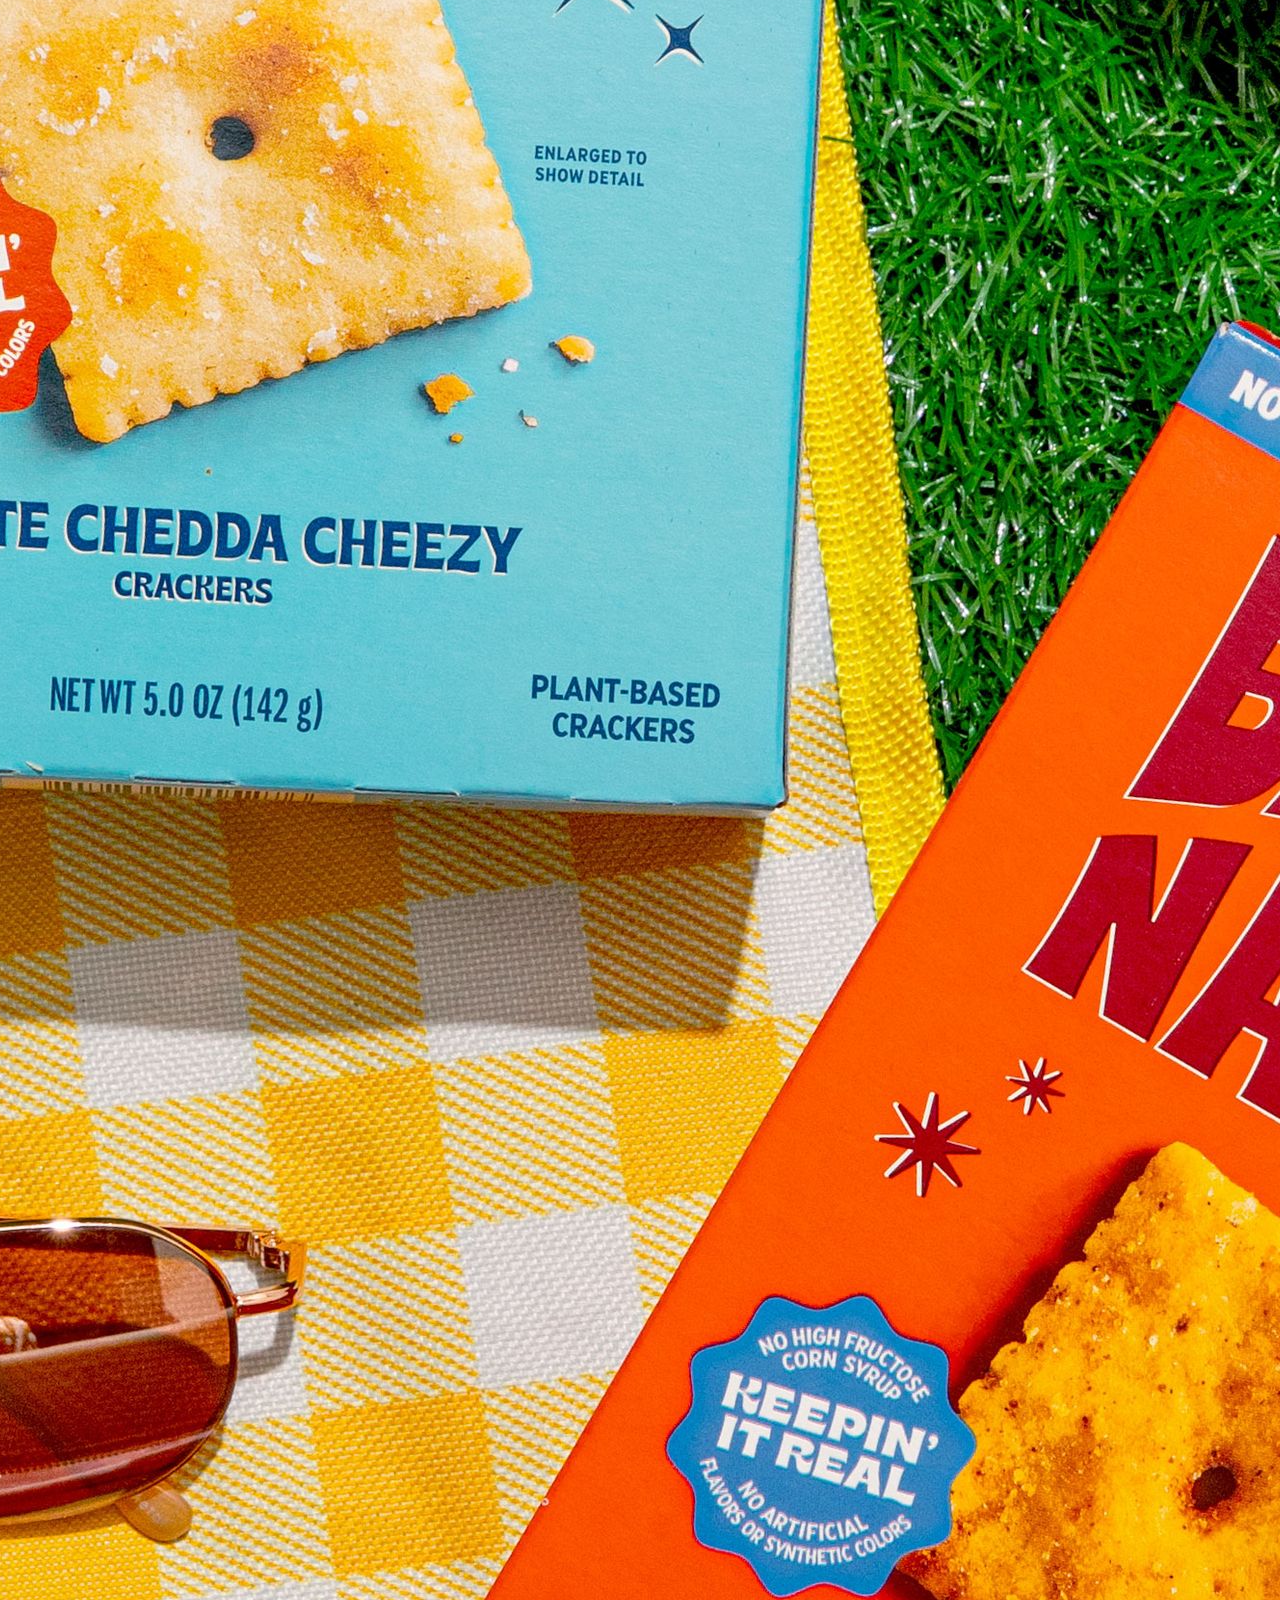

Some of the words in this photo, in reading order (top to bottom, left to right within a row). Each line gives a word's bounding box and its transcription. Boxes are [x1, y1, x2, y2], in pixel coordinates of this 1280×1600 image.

[534, 145, 622, 164] ENLARGED
[626, 151, 647, 166] TO
[535, 167, 584, 184] SHOW
[588, 170, 645, 187] DETAIL
[63, 502, 289, 564] CHEDDA
[300, 516, 523, 576] CHEEZY
[112, 570, 274, 606] CRACKERS
[50, 676, 96, 713] NET
[100, 679, 137, 715] WT
[143, 681, 184, 717] 5.0
[193, 683, 224, 720] OZ
[232, 684, 288, 727] (142
[296, 688, 323, 733] g)
[531, 674, 721, 709] PLANT-BASED
[552, 712, 695, 744] CRACKERS
[757, 1331, 788, 1357] NO
[791, 1326, 841, 1348] HIGH
[843, 1330, 931, 1405] FRUCTOSE
[781, 1350, 837, 1372] CORN
[842, 1355, 902, 1402] SYRUP
[716, 1413, 771, 1459] IT
[774, 1430, 916, 1507] REAL
[698, 1456, 746, 1525] FLAVORS
[740, 1520, 767, 1546] OR
[764, 1535, 853, 1566] SYNTHETIC
[854, 1514, 913, 1557] COLORS
[737, 1479, 765, 1511] NO
[760, 1507, 870, 1542] ARTIFICIAL
